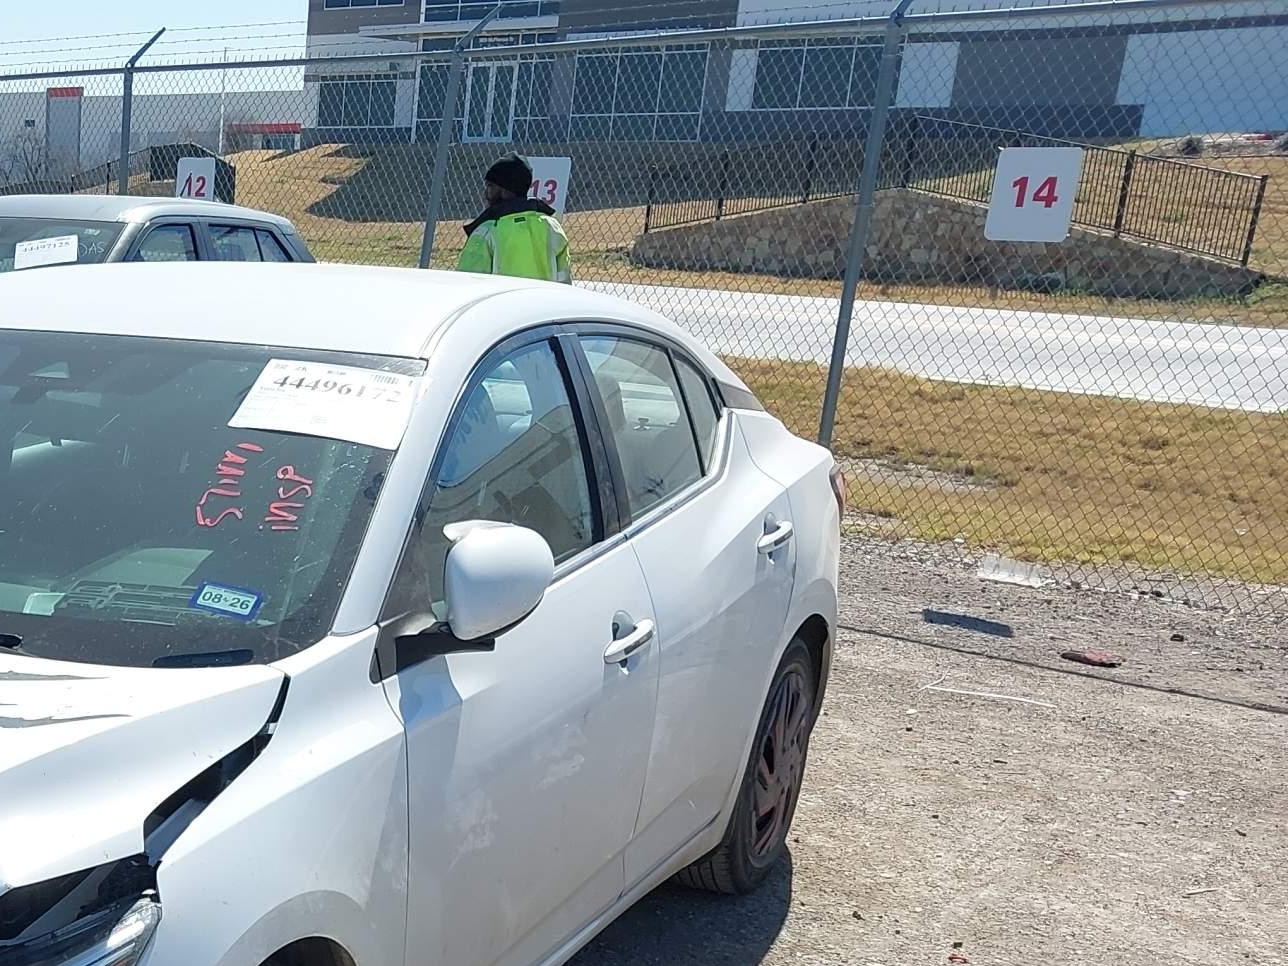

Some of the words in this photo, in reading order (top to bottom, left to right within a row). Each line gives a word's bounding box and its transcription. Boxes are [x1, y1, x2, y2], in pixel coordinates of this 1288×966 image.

[186, 174, 207, 198] 12
[530, 179, 558, 205] 13
[1012, 175, 1059, 209] 14
[272, 374, 402, 404] 44496172
